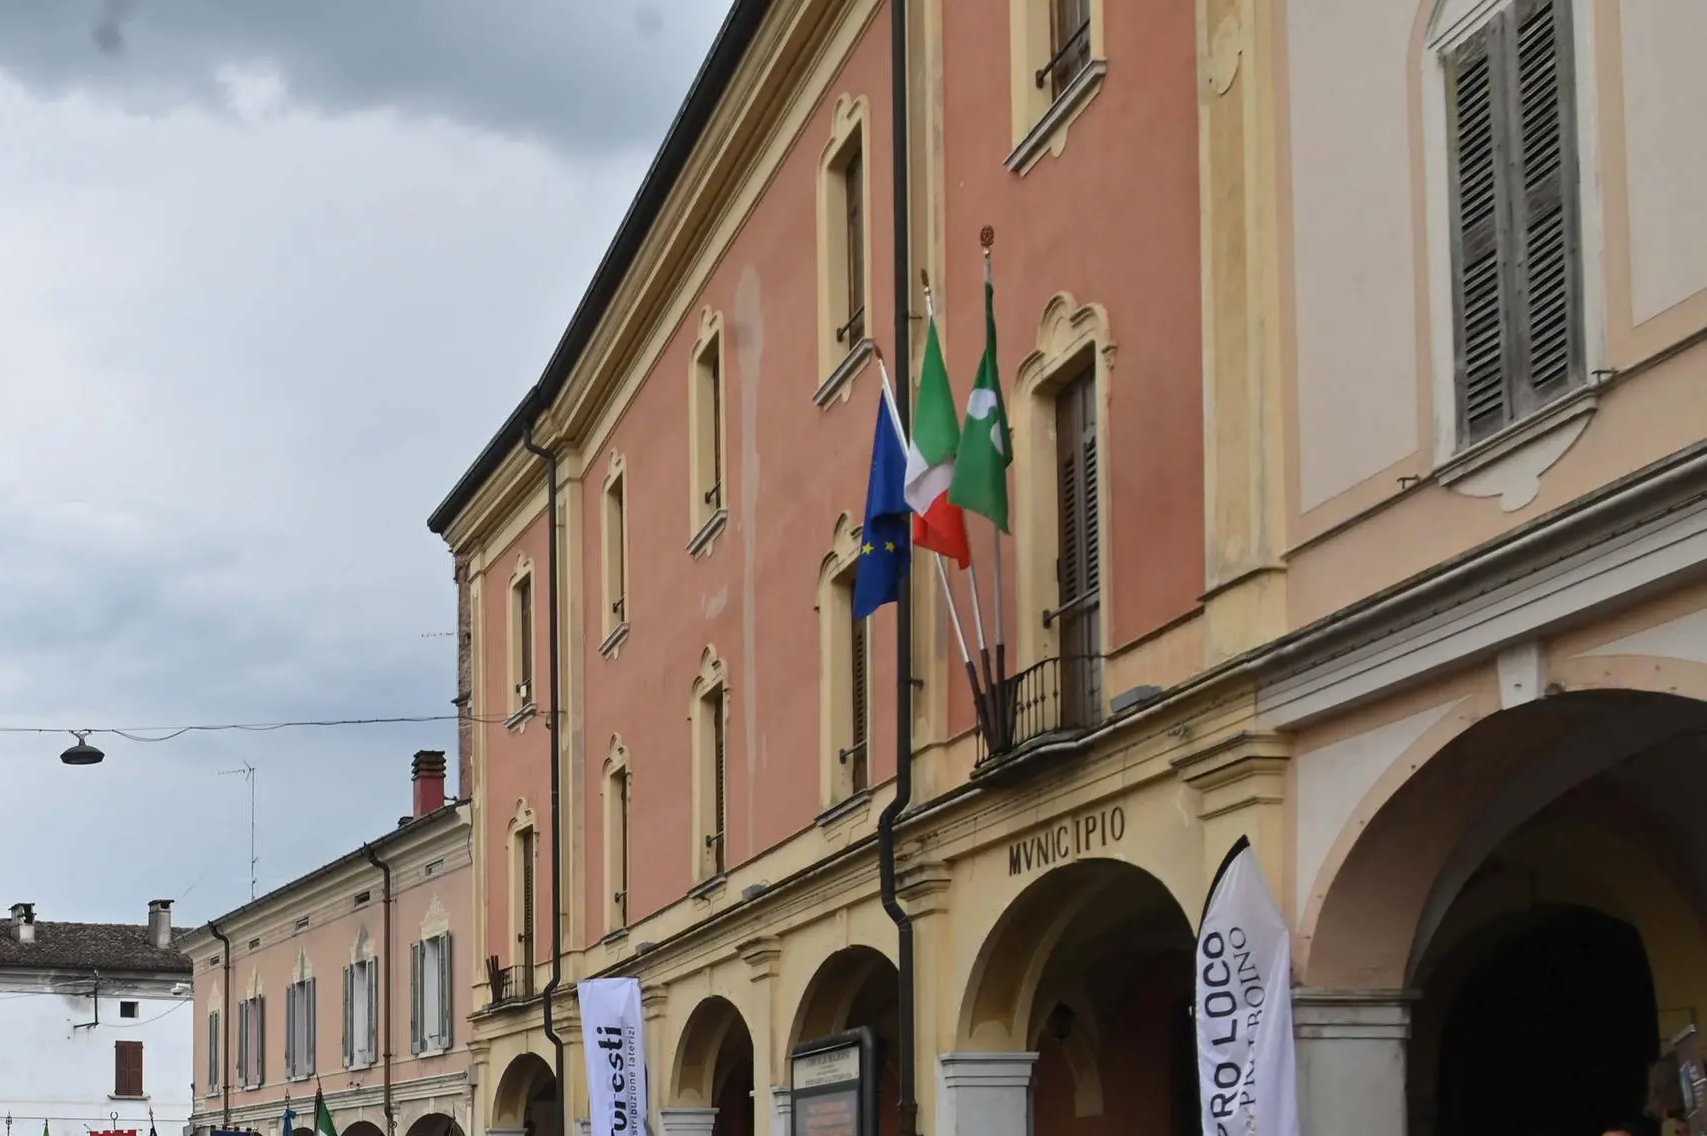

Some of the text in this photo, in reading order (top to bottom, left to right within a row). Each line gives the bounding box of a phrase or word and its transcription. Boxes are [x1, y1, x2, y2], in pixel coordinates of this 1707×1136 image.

[1009, 806, 1125, 876] MVNICIPIO
[1202, 931, 1238, 1046] LOCO
[626, 1025, 636, 1067] laterizi
